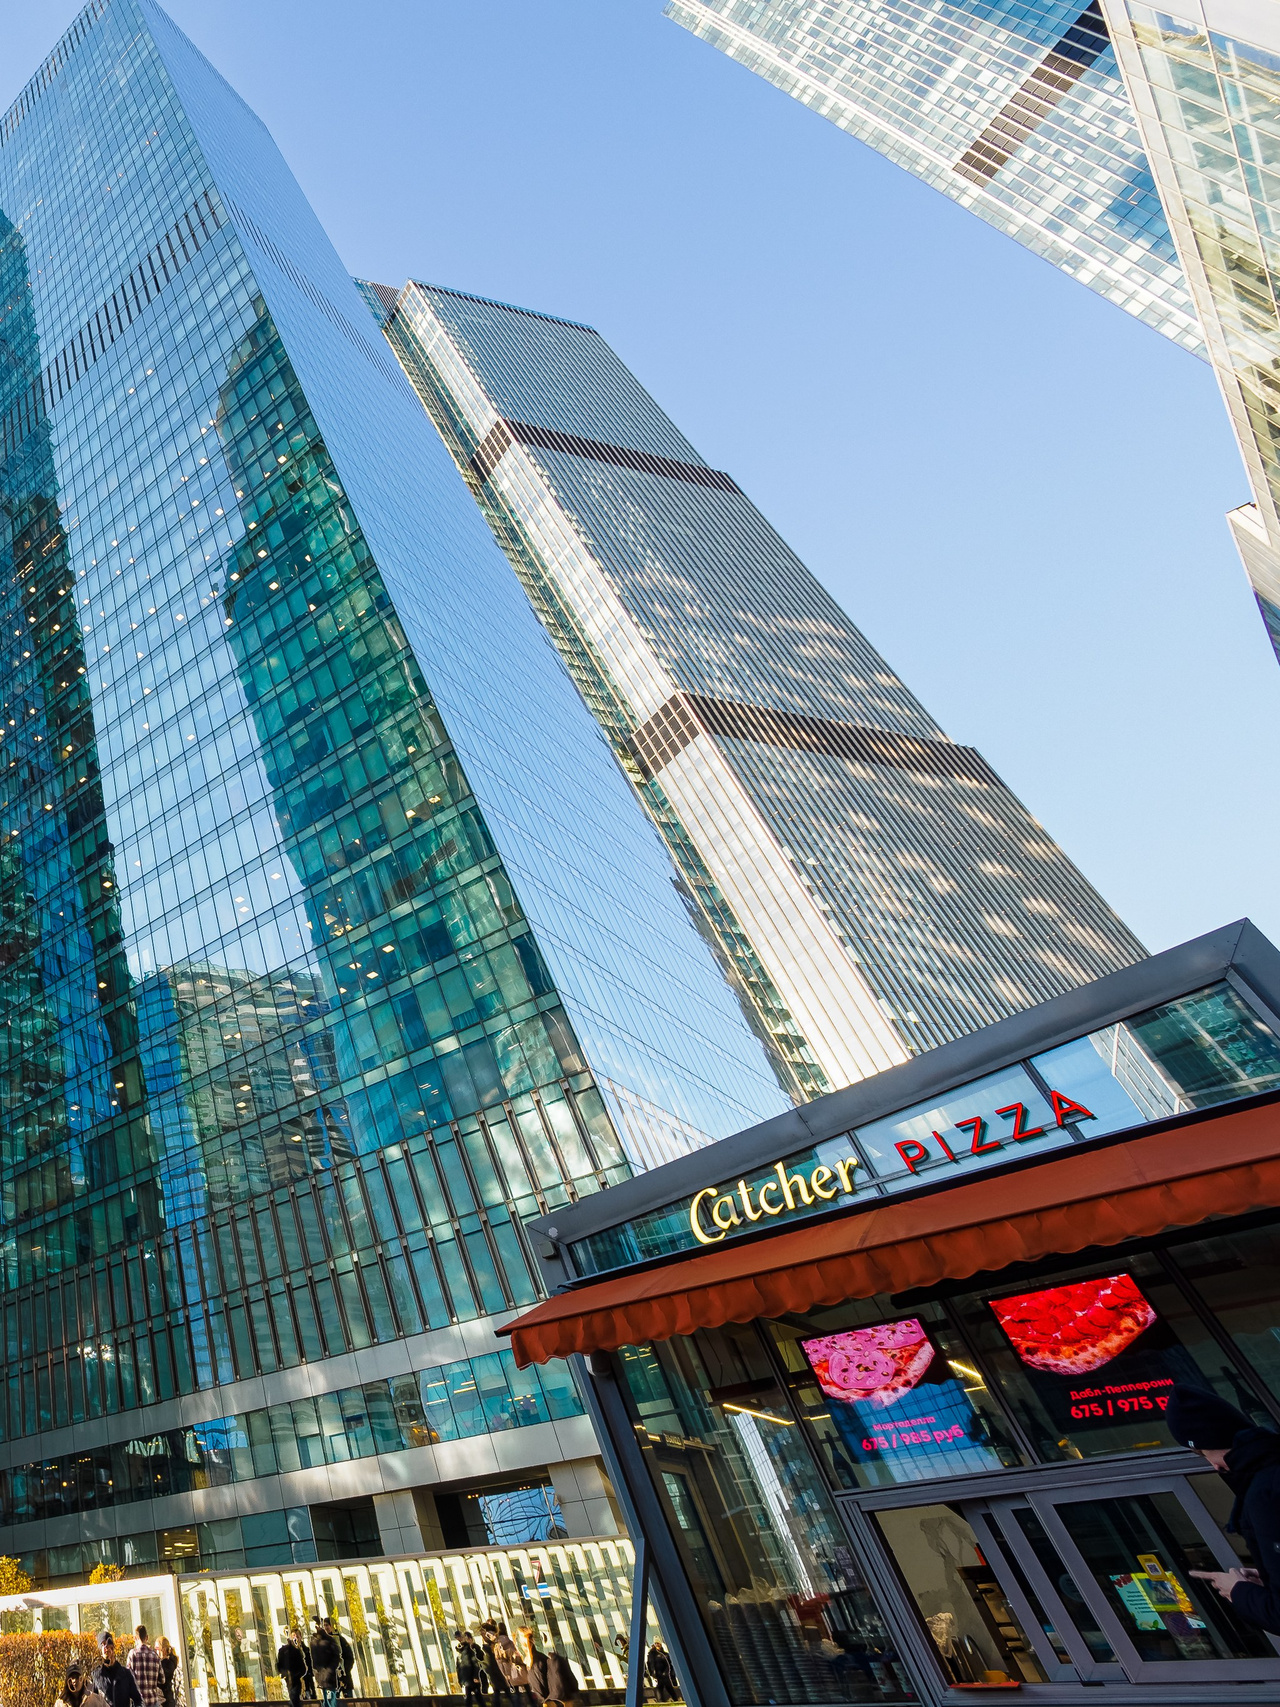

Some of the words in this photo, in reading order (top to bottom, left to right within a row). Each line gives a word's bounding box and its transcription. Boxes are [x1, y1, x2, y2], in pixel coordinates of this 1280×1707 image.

[690, 1156, 860, 1244] Catcher
[894, 1089, 1094, 1174] PIZZA
[1070, 1403, 1103, 1419] 675
[1117, 1396, 1154, 1412] 975
[862, 1436, 889, 1451] 675
[900, 1430, 931, 1445] 985
[932, 1424, 964, 1443] руб
